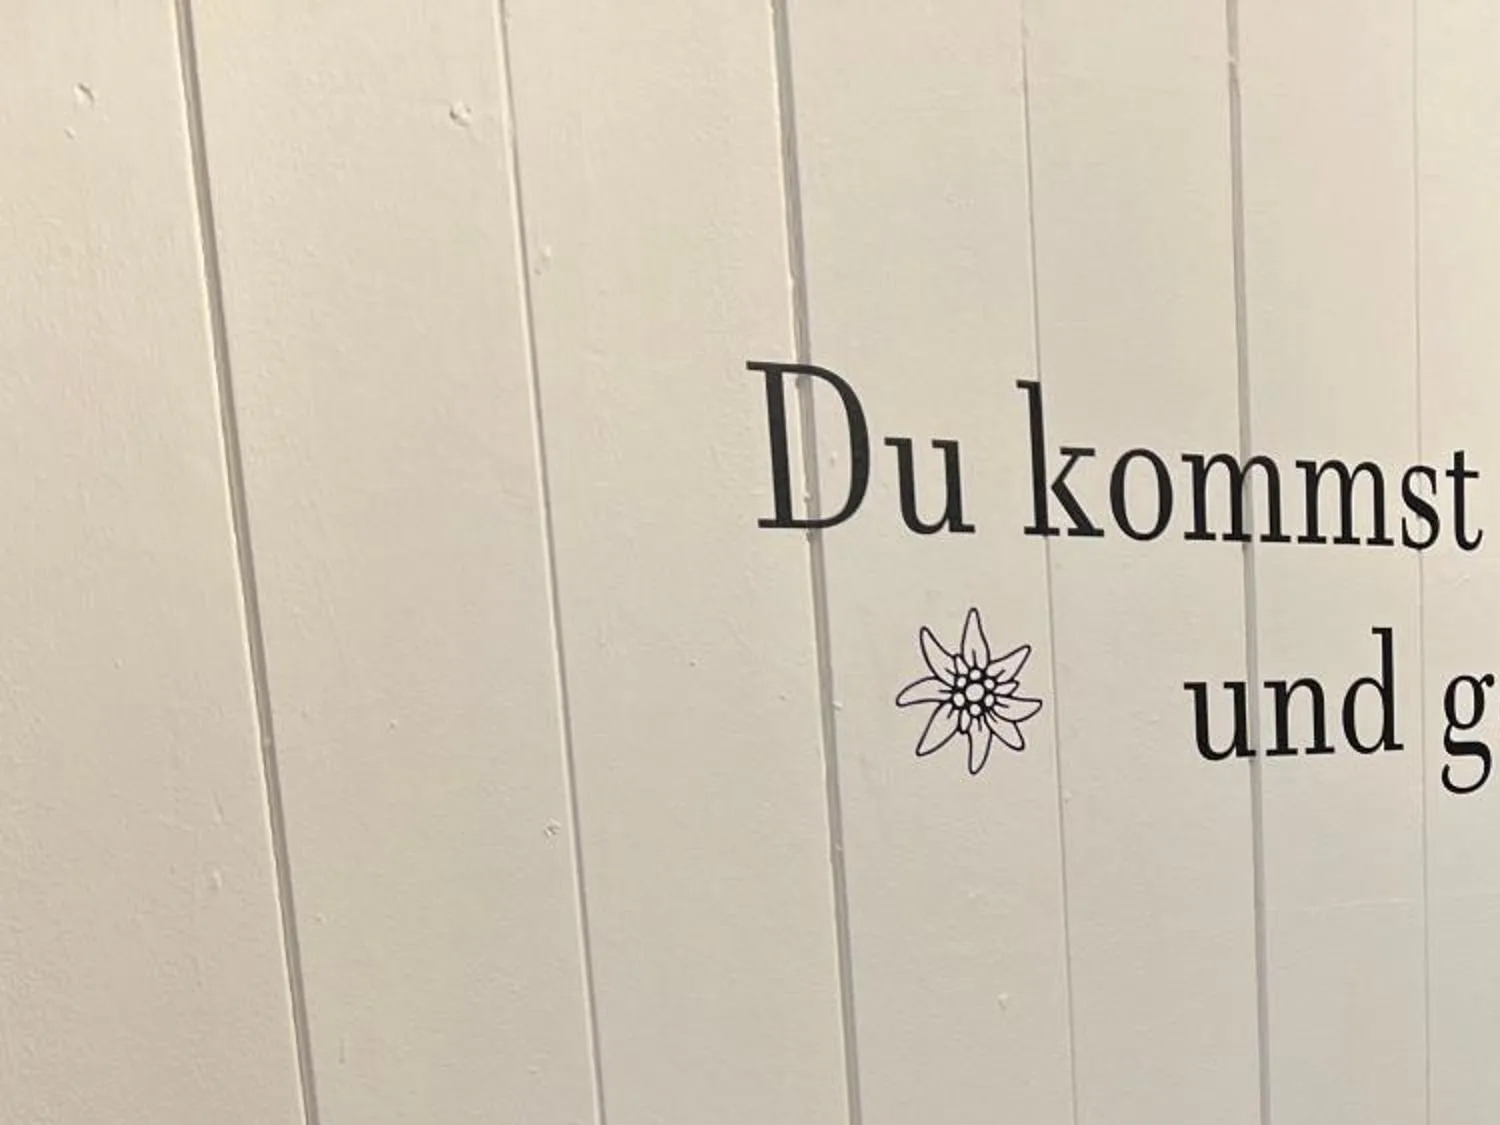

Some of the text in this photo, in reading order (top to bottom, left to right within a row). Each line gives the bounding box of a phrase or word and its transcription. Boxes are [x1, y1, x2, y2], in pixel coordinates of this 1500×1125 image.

[746, 361, 975, 535] Du
[1016, 380, 1484, 551] kommst
[1183, 627, 1404, 761] und
